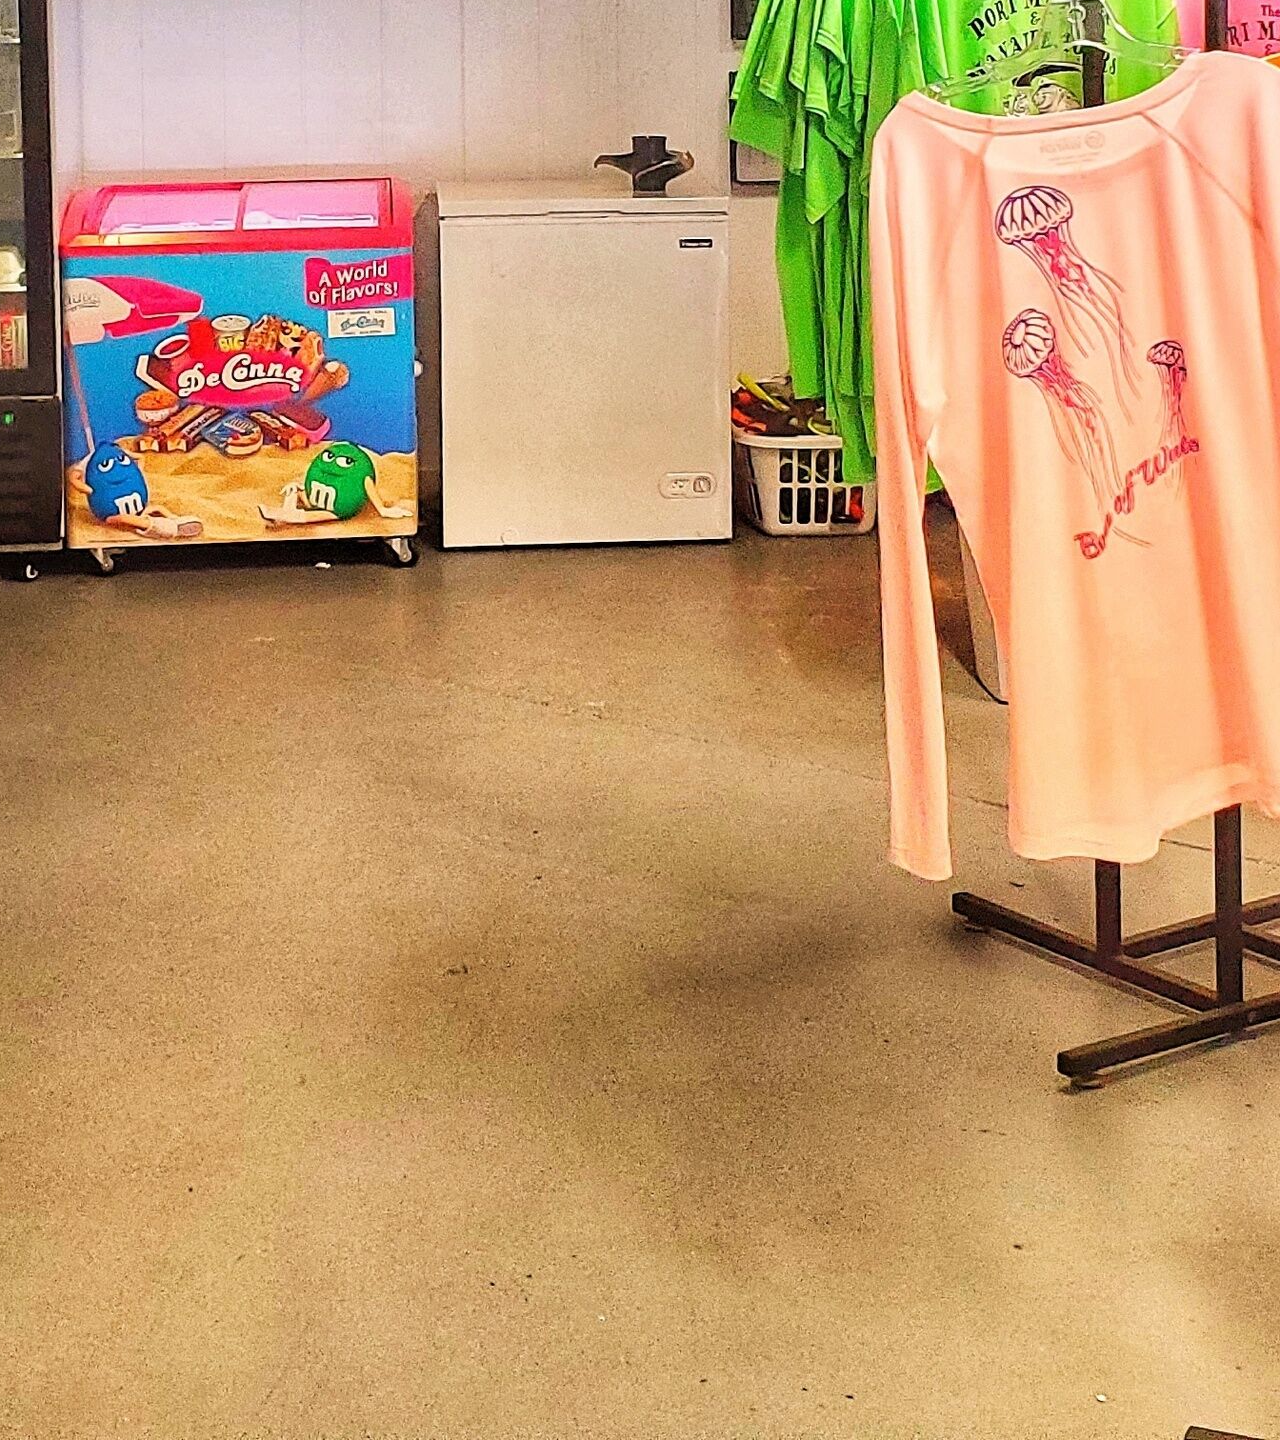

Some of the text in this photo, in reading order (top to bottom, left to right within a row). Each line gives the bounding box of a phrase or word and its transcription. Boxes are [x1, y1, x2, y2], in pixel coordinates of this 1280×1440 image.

[1260, 4, 1280, 17] The
[318, 259, 388, 288] A World
[308, 281, 399, 305] of Flavors!
[178, 353, 304, 397] DeConna
